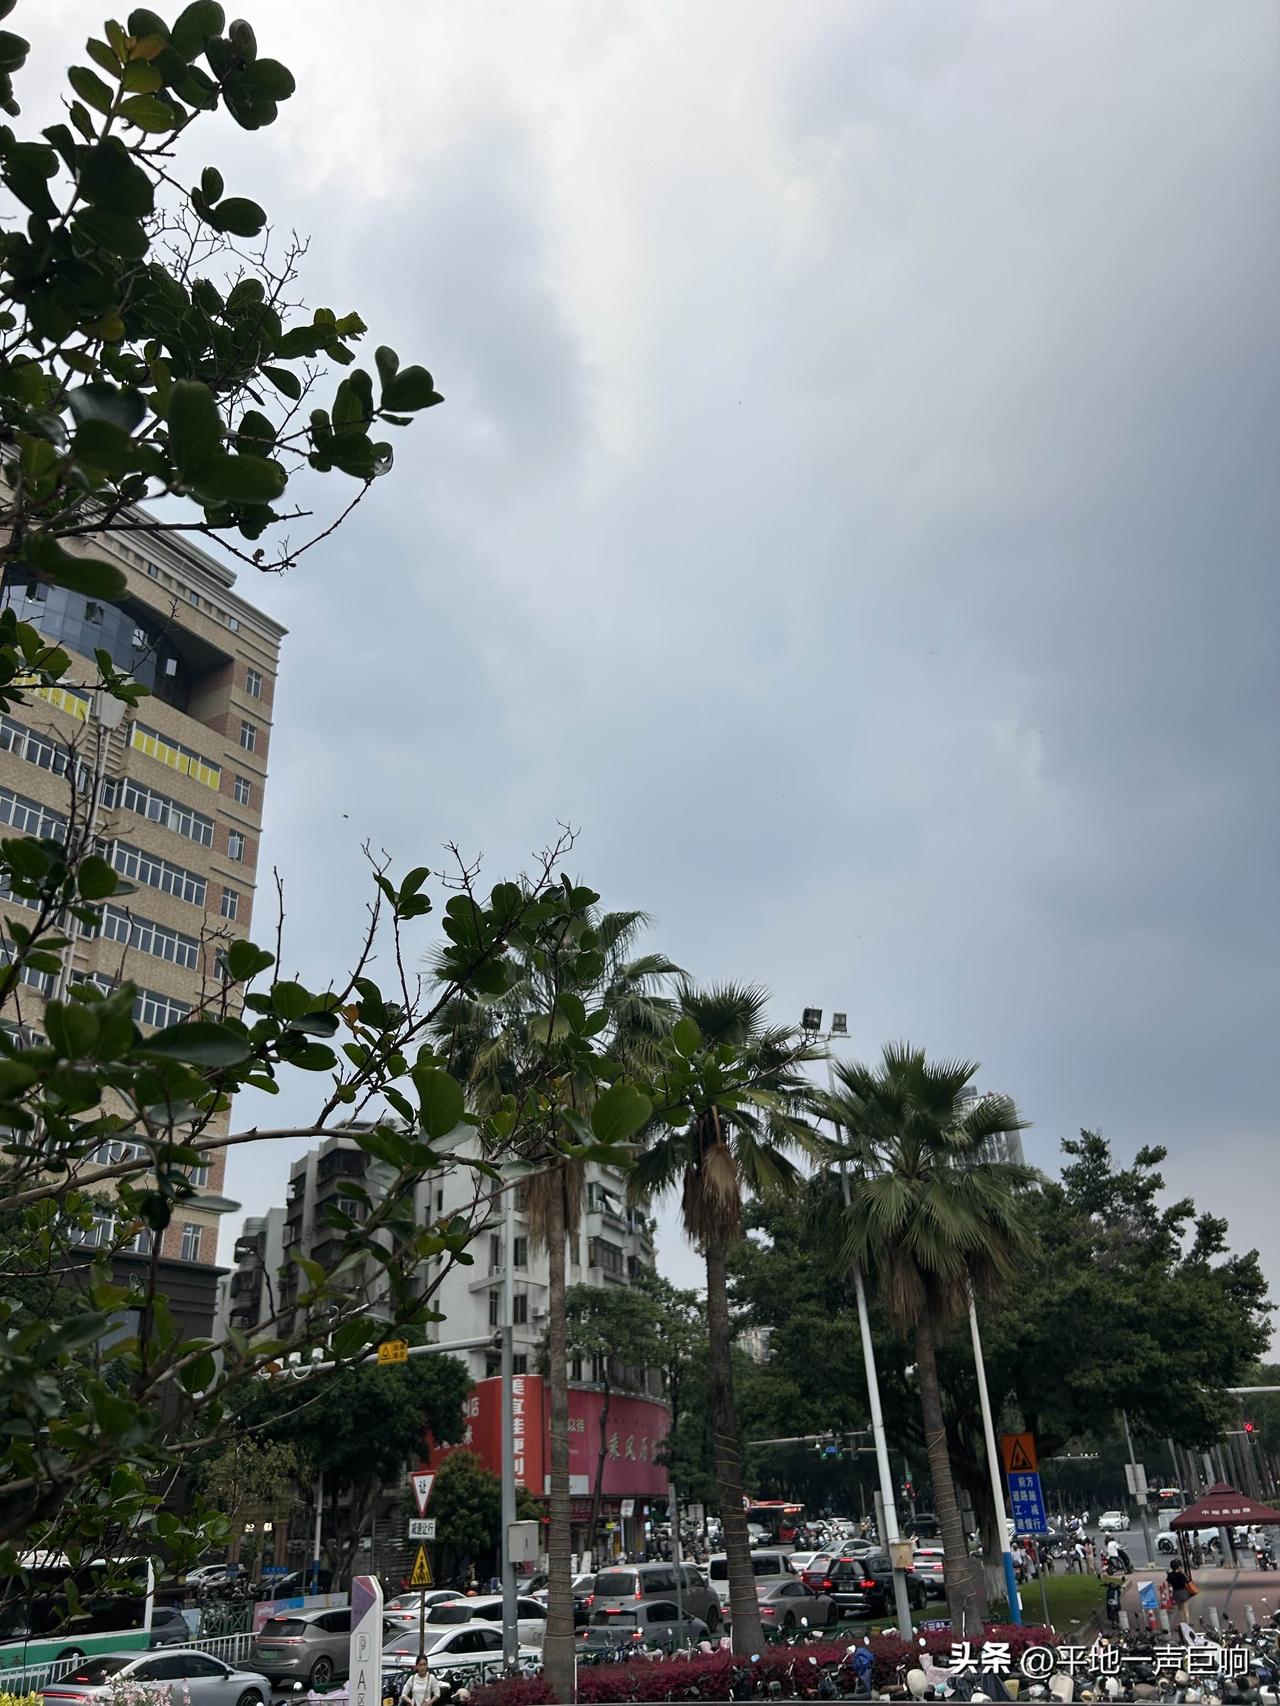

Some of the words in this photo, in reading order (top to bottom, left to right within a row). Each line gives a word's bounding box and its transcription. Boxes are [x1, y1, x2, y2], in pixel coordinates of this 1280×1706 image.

[418, 1479, 427, 1494] 让
[411, 1522, 433, 1535] 减速让行
